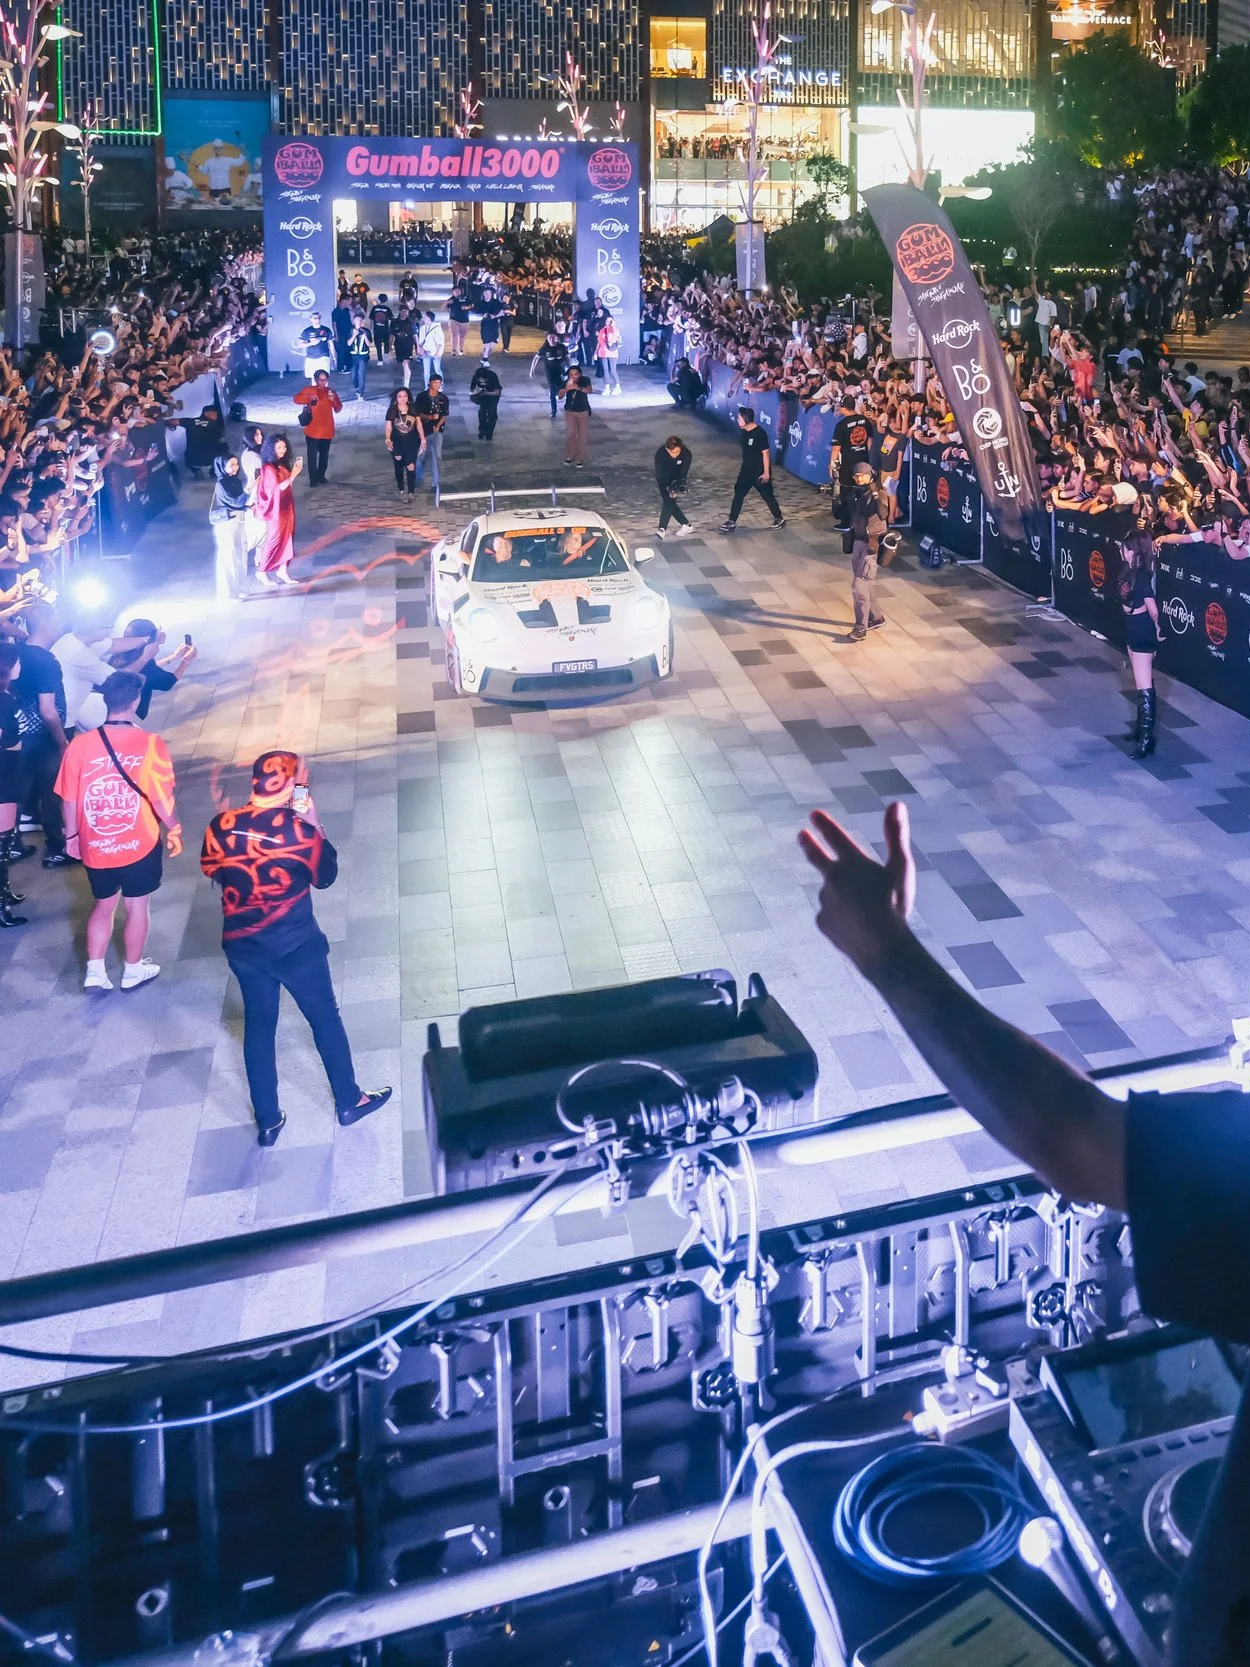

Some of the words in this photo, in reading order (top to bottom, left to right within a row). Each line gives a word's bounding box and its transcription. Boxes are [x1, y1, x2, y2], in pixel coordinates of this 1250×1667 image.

[774, 56, 793, 65] THE
[723, 69, 842, 87] EXCHANGE
[346, 145, 560, 177] Gumball3000
[280, 221, 302, 231] Hard
[302, 221, 323, 232] Rock
[590, 223, 610, 232] Hard
[611, 223, 630, 232] Rock
[932, 328, 957, 346] Hard
[957, 319, 982, 337] Rock
[1162, 600, 1178, 617] Hard
[1178, 606, 1195, 628] Rock
